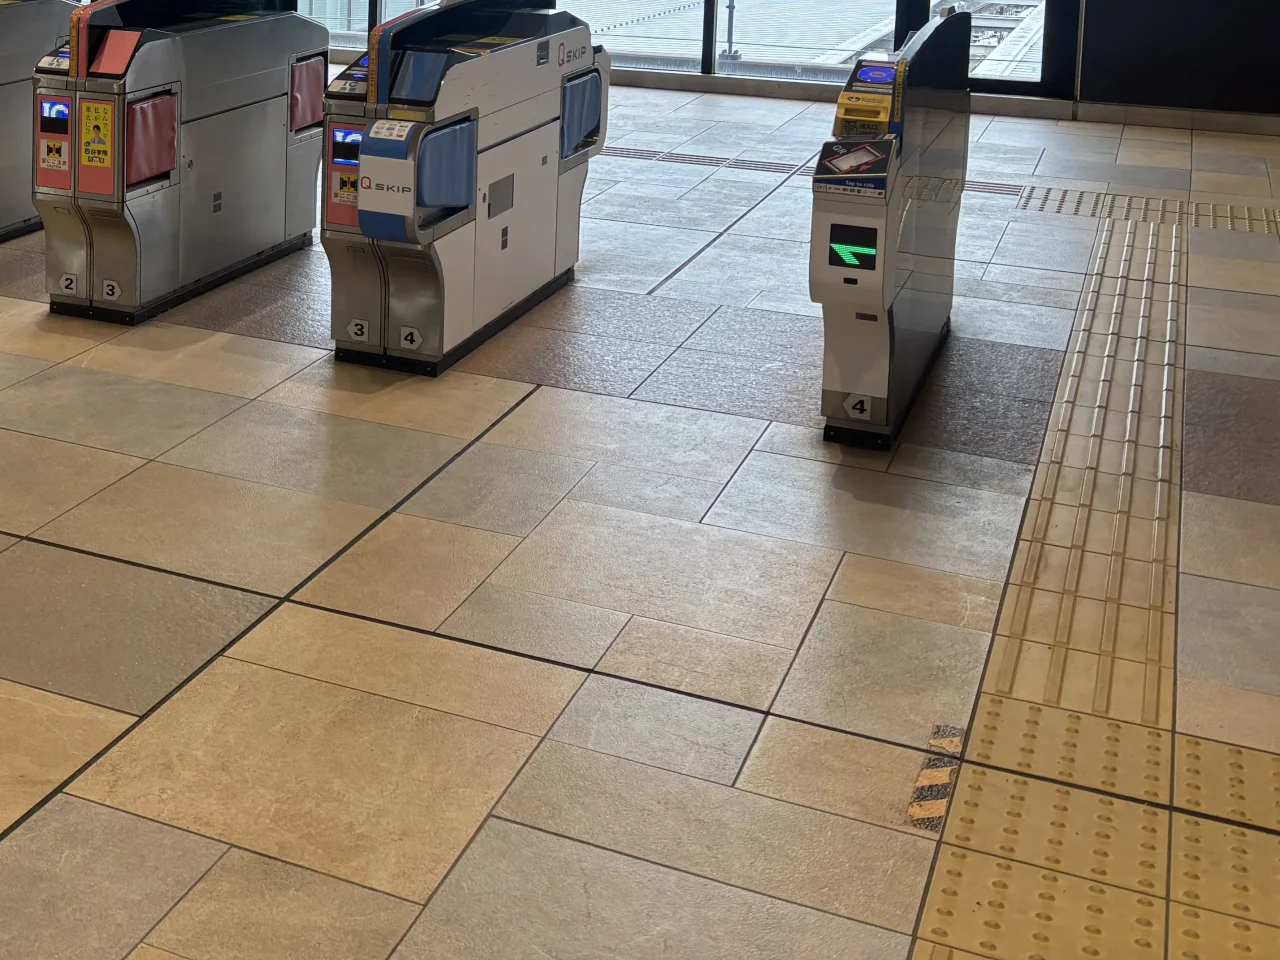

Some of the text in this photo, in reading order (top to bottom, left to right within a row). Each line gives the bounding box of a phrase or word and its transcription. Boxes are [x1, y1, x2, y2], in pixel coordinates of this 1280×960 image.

[557, 42, 587, 67] Q SKIP
[84, 148, 108, 157] 四谷学院
[832, 144, 847, 155] QR
[360, 176, 412, 193] Q SKIP
[64, 278, 74, 290] 2
[105, 284, 115, 296] 3
[353, 323, 365, 337] 3
[403, 332, 416, 345] 4
[851, 399, 867, 415] 4
